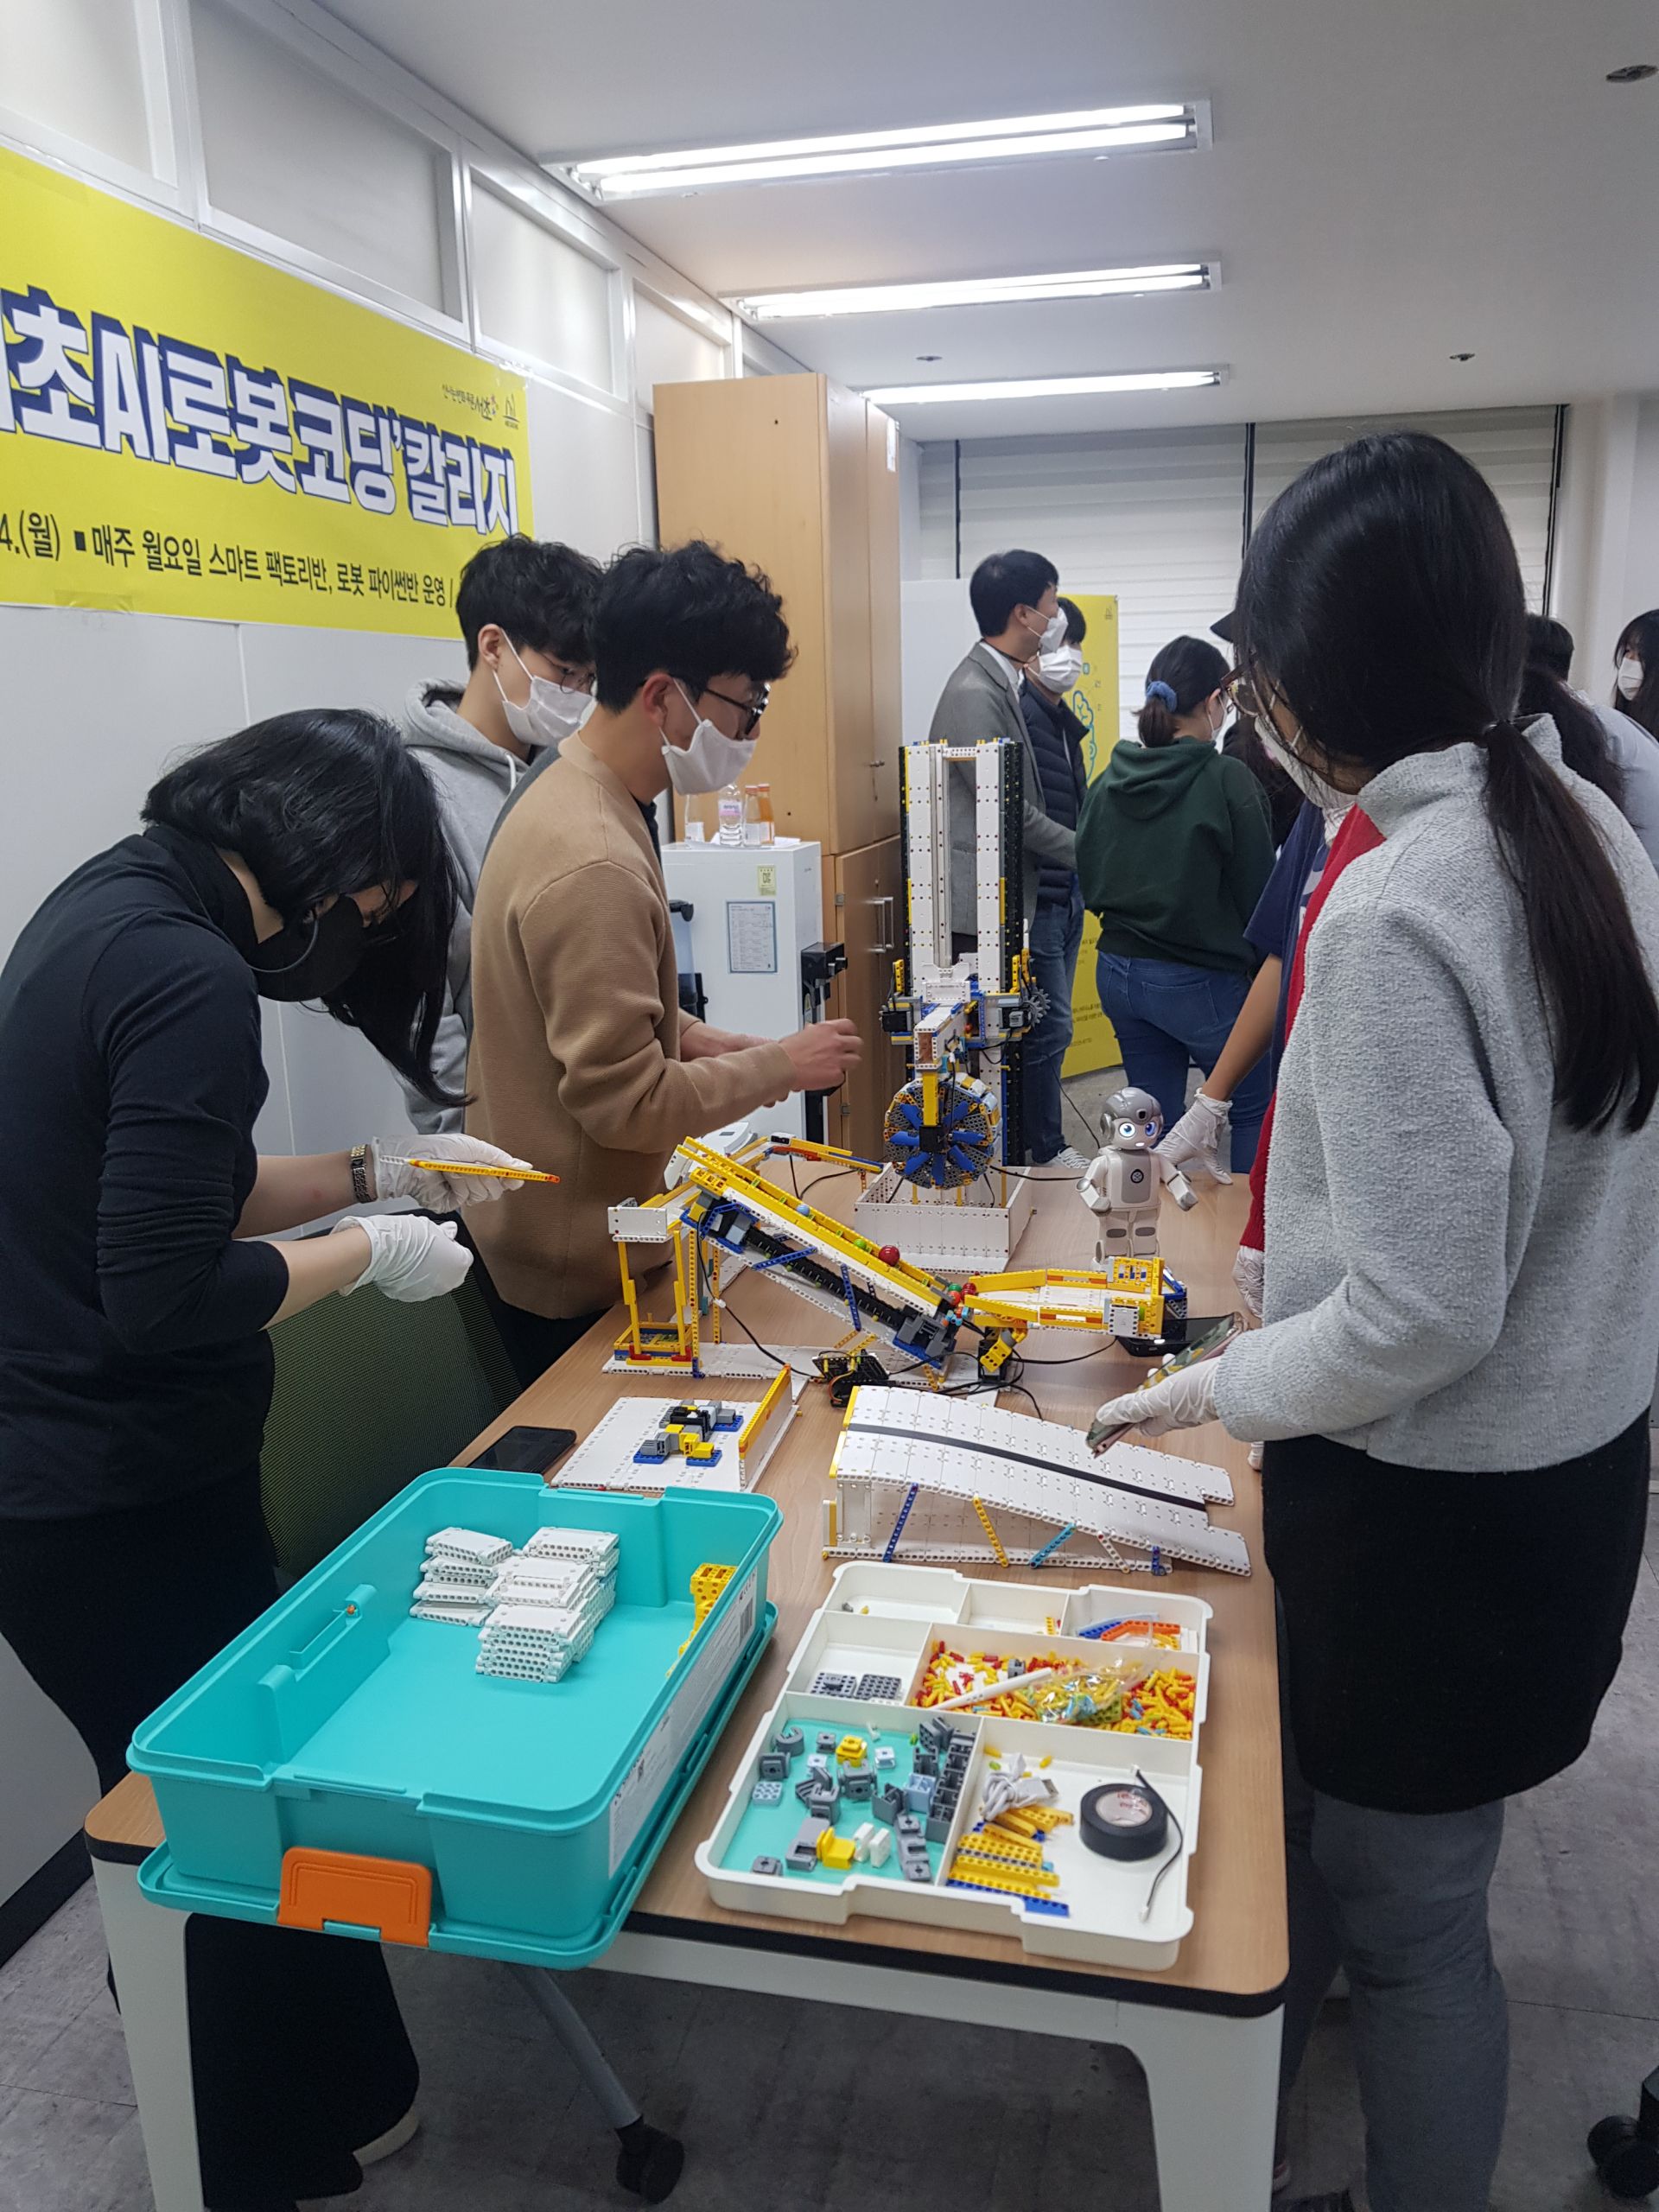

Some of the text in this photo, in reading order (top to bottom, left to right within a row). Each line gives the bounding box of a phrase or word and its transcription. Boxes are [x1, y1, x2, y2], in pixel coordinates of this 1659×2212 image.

[92, 524, 135, 568] 매주
[142, 530, 202, 576] 월요일
[209, 543, 261, 582] 스마트
[265, 550, 333, 595] 팩토리반,
[337, 563, 365, 597] 로봇
[368, 567, 419, 603] 파이썬반
[423, 574, 446, 607] 운영
